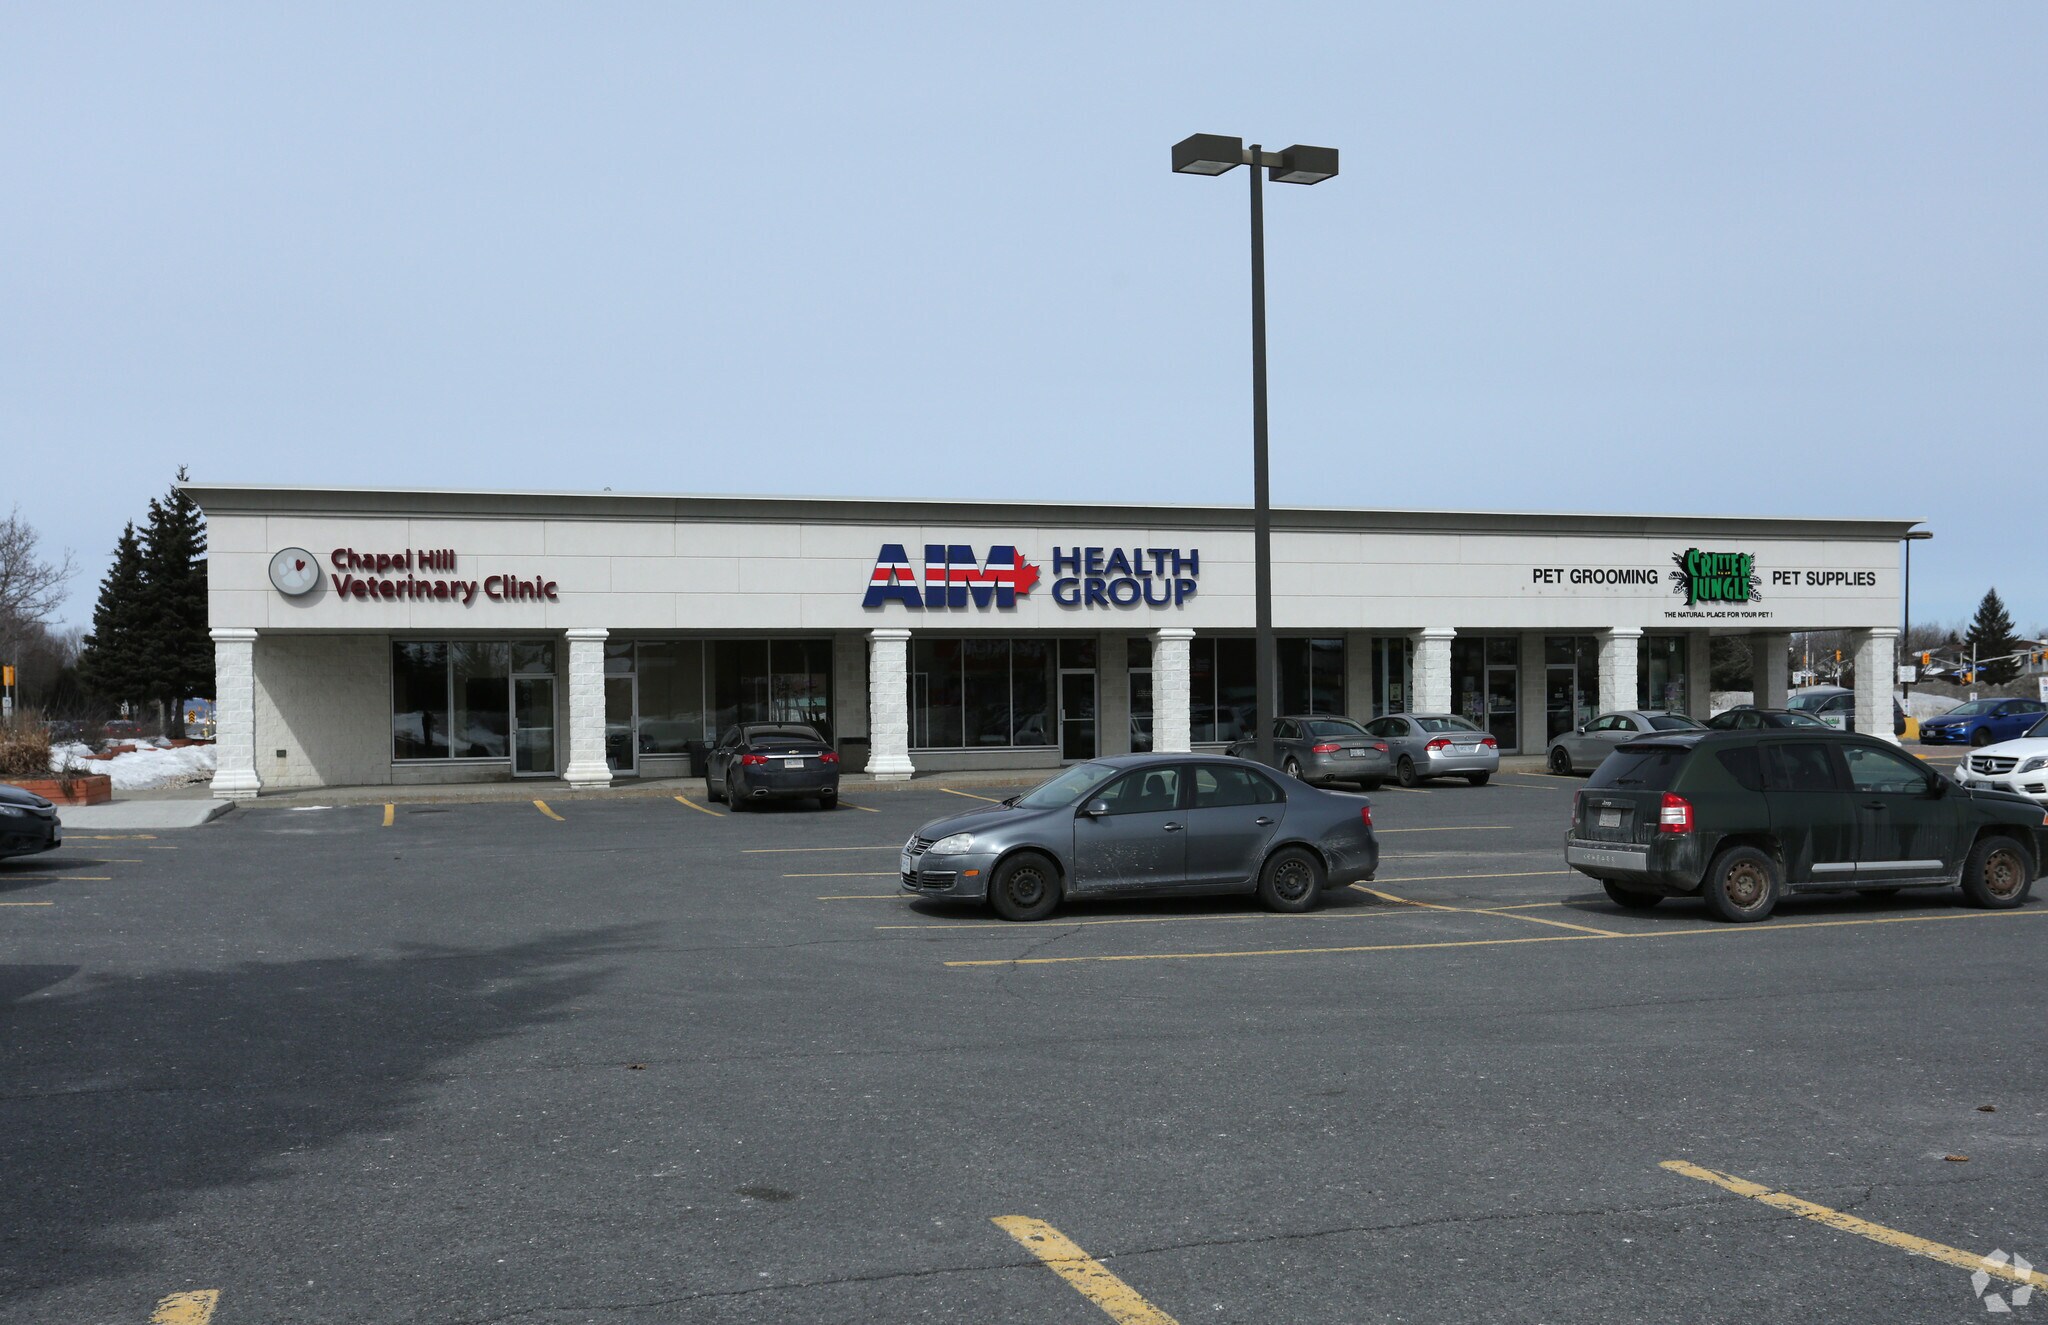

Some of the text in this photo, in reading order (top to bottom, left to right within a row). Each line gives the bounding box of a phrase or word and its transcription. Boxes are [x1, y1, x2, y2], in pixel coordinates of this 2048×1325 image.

[331, 548, 455, 573] Chapel Hill
[1052, 546, 1199, 575] HEALTH
[331, 573, 558, 604] Veterinary Clinic
[862, 543, 1015, 607] AIM
[1533, 568, 1658, 585] PET GROOMING
[1772, 570, 1876, 586] PET SUPPLIES
[1051, 577, 1197, 606] GROUP
[1691, 576, 1751, 604] JUNGLE
